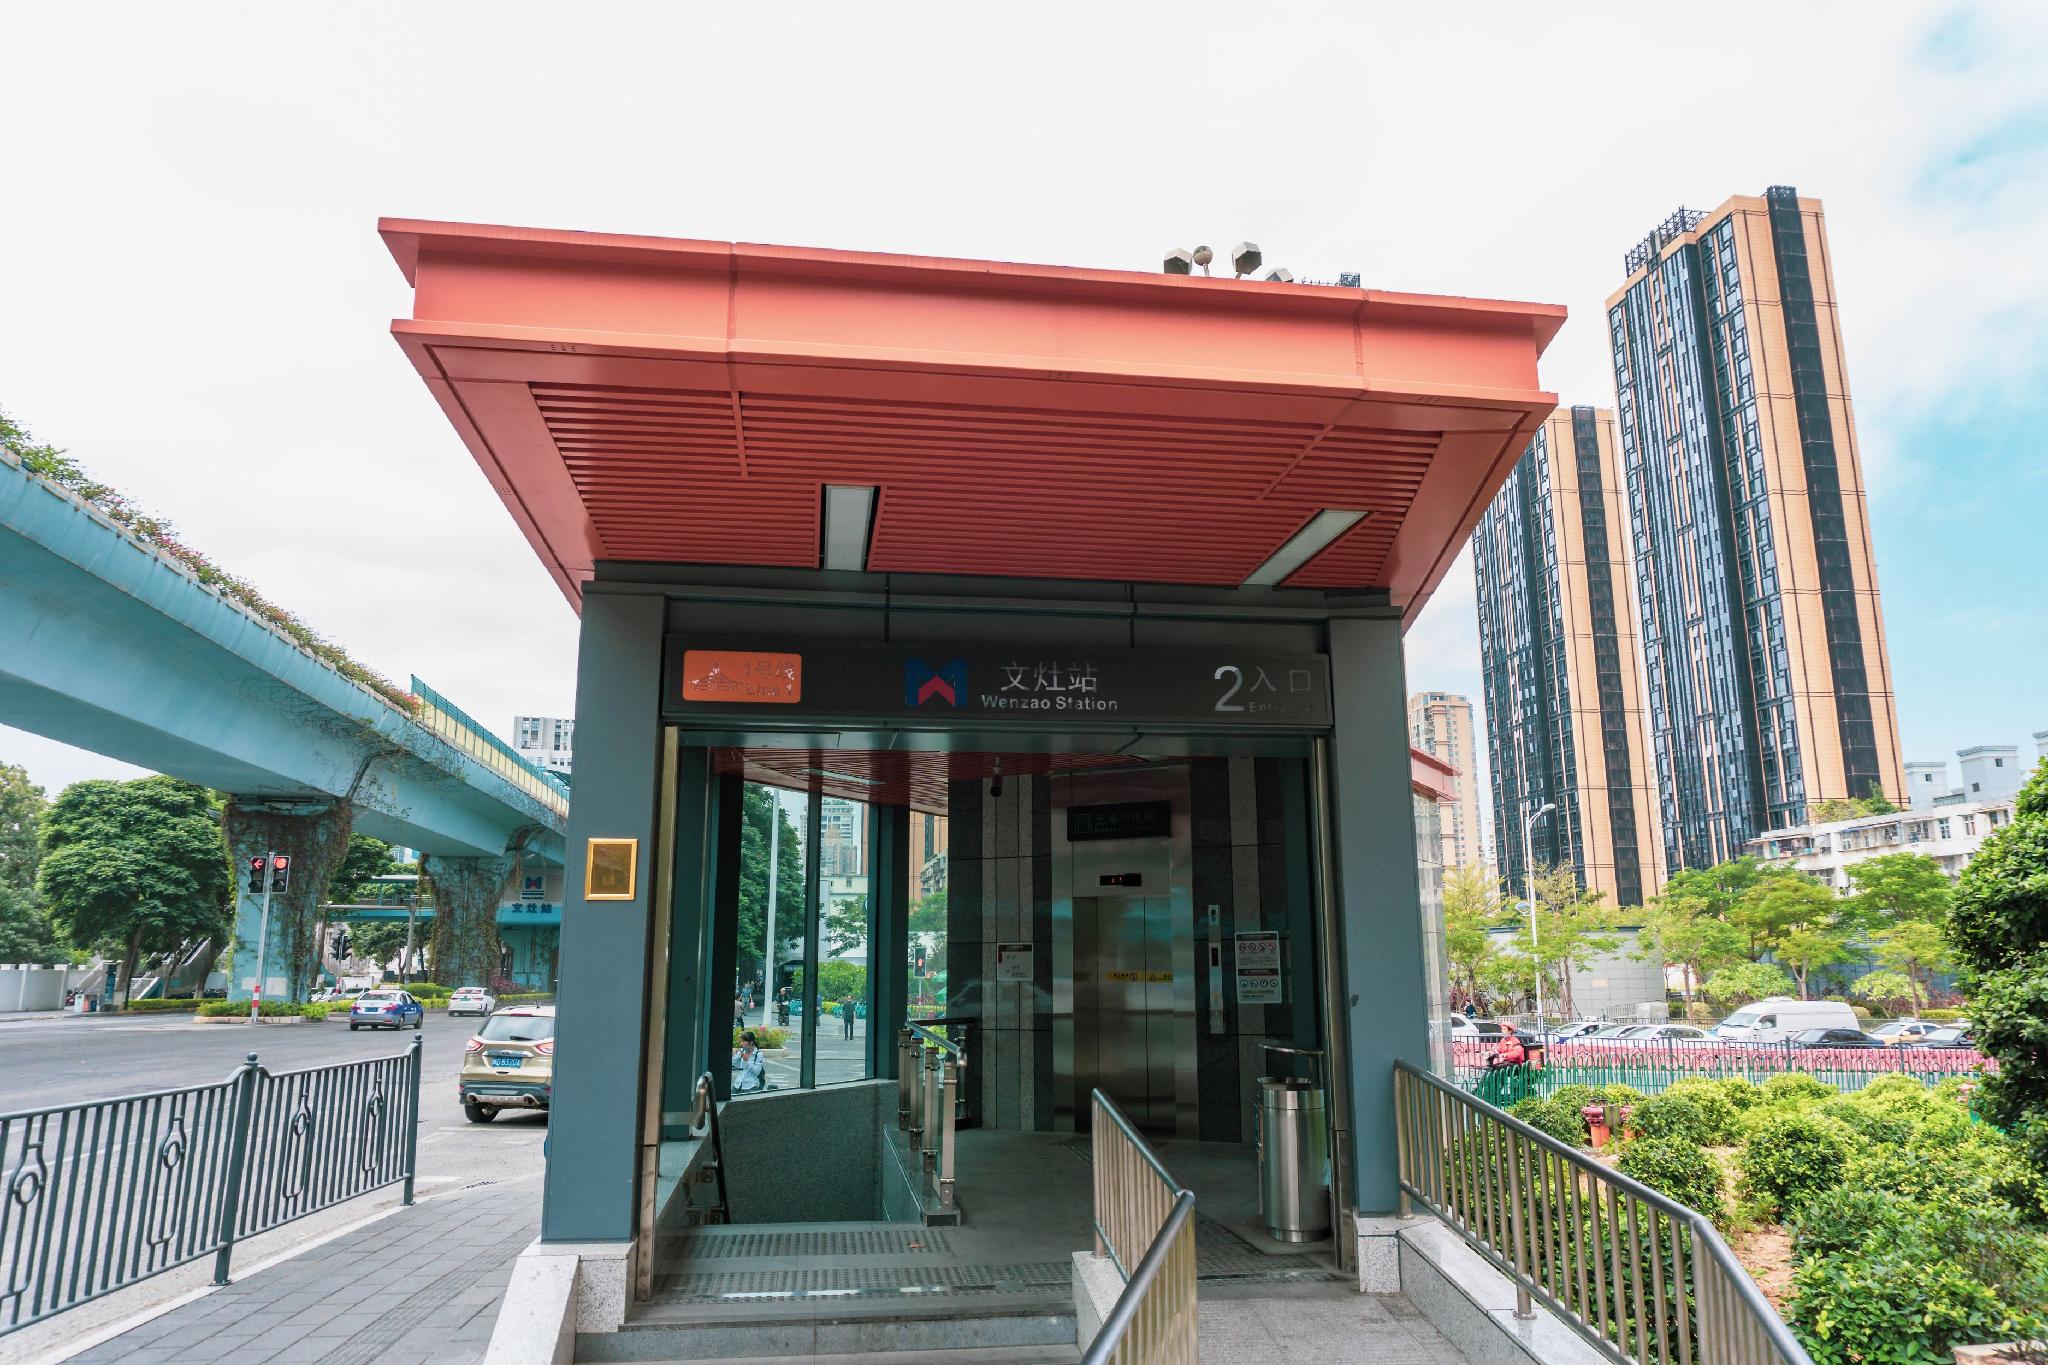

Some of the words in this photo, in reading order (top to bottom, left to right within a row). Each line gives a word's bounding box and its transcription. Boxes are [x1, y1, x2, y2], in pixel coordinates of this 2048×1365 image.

[1000, 660, 1099, 693] 文灶站
[1214, 665, 1245, 712] 2
[1249, 666, 1311, 692] 入口
[981, 694, 1050, 710] Wenzao
[1055, 696, 1118, 711] Station
